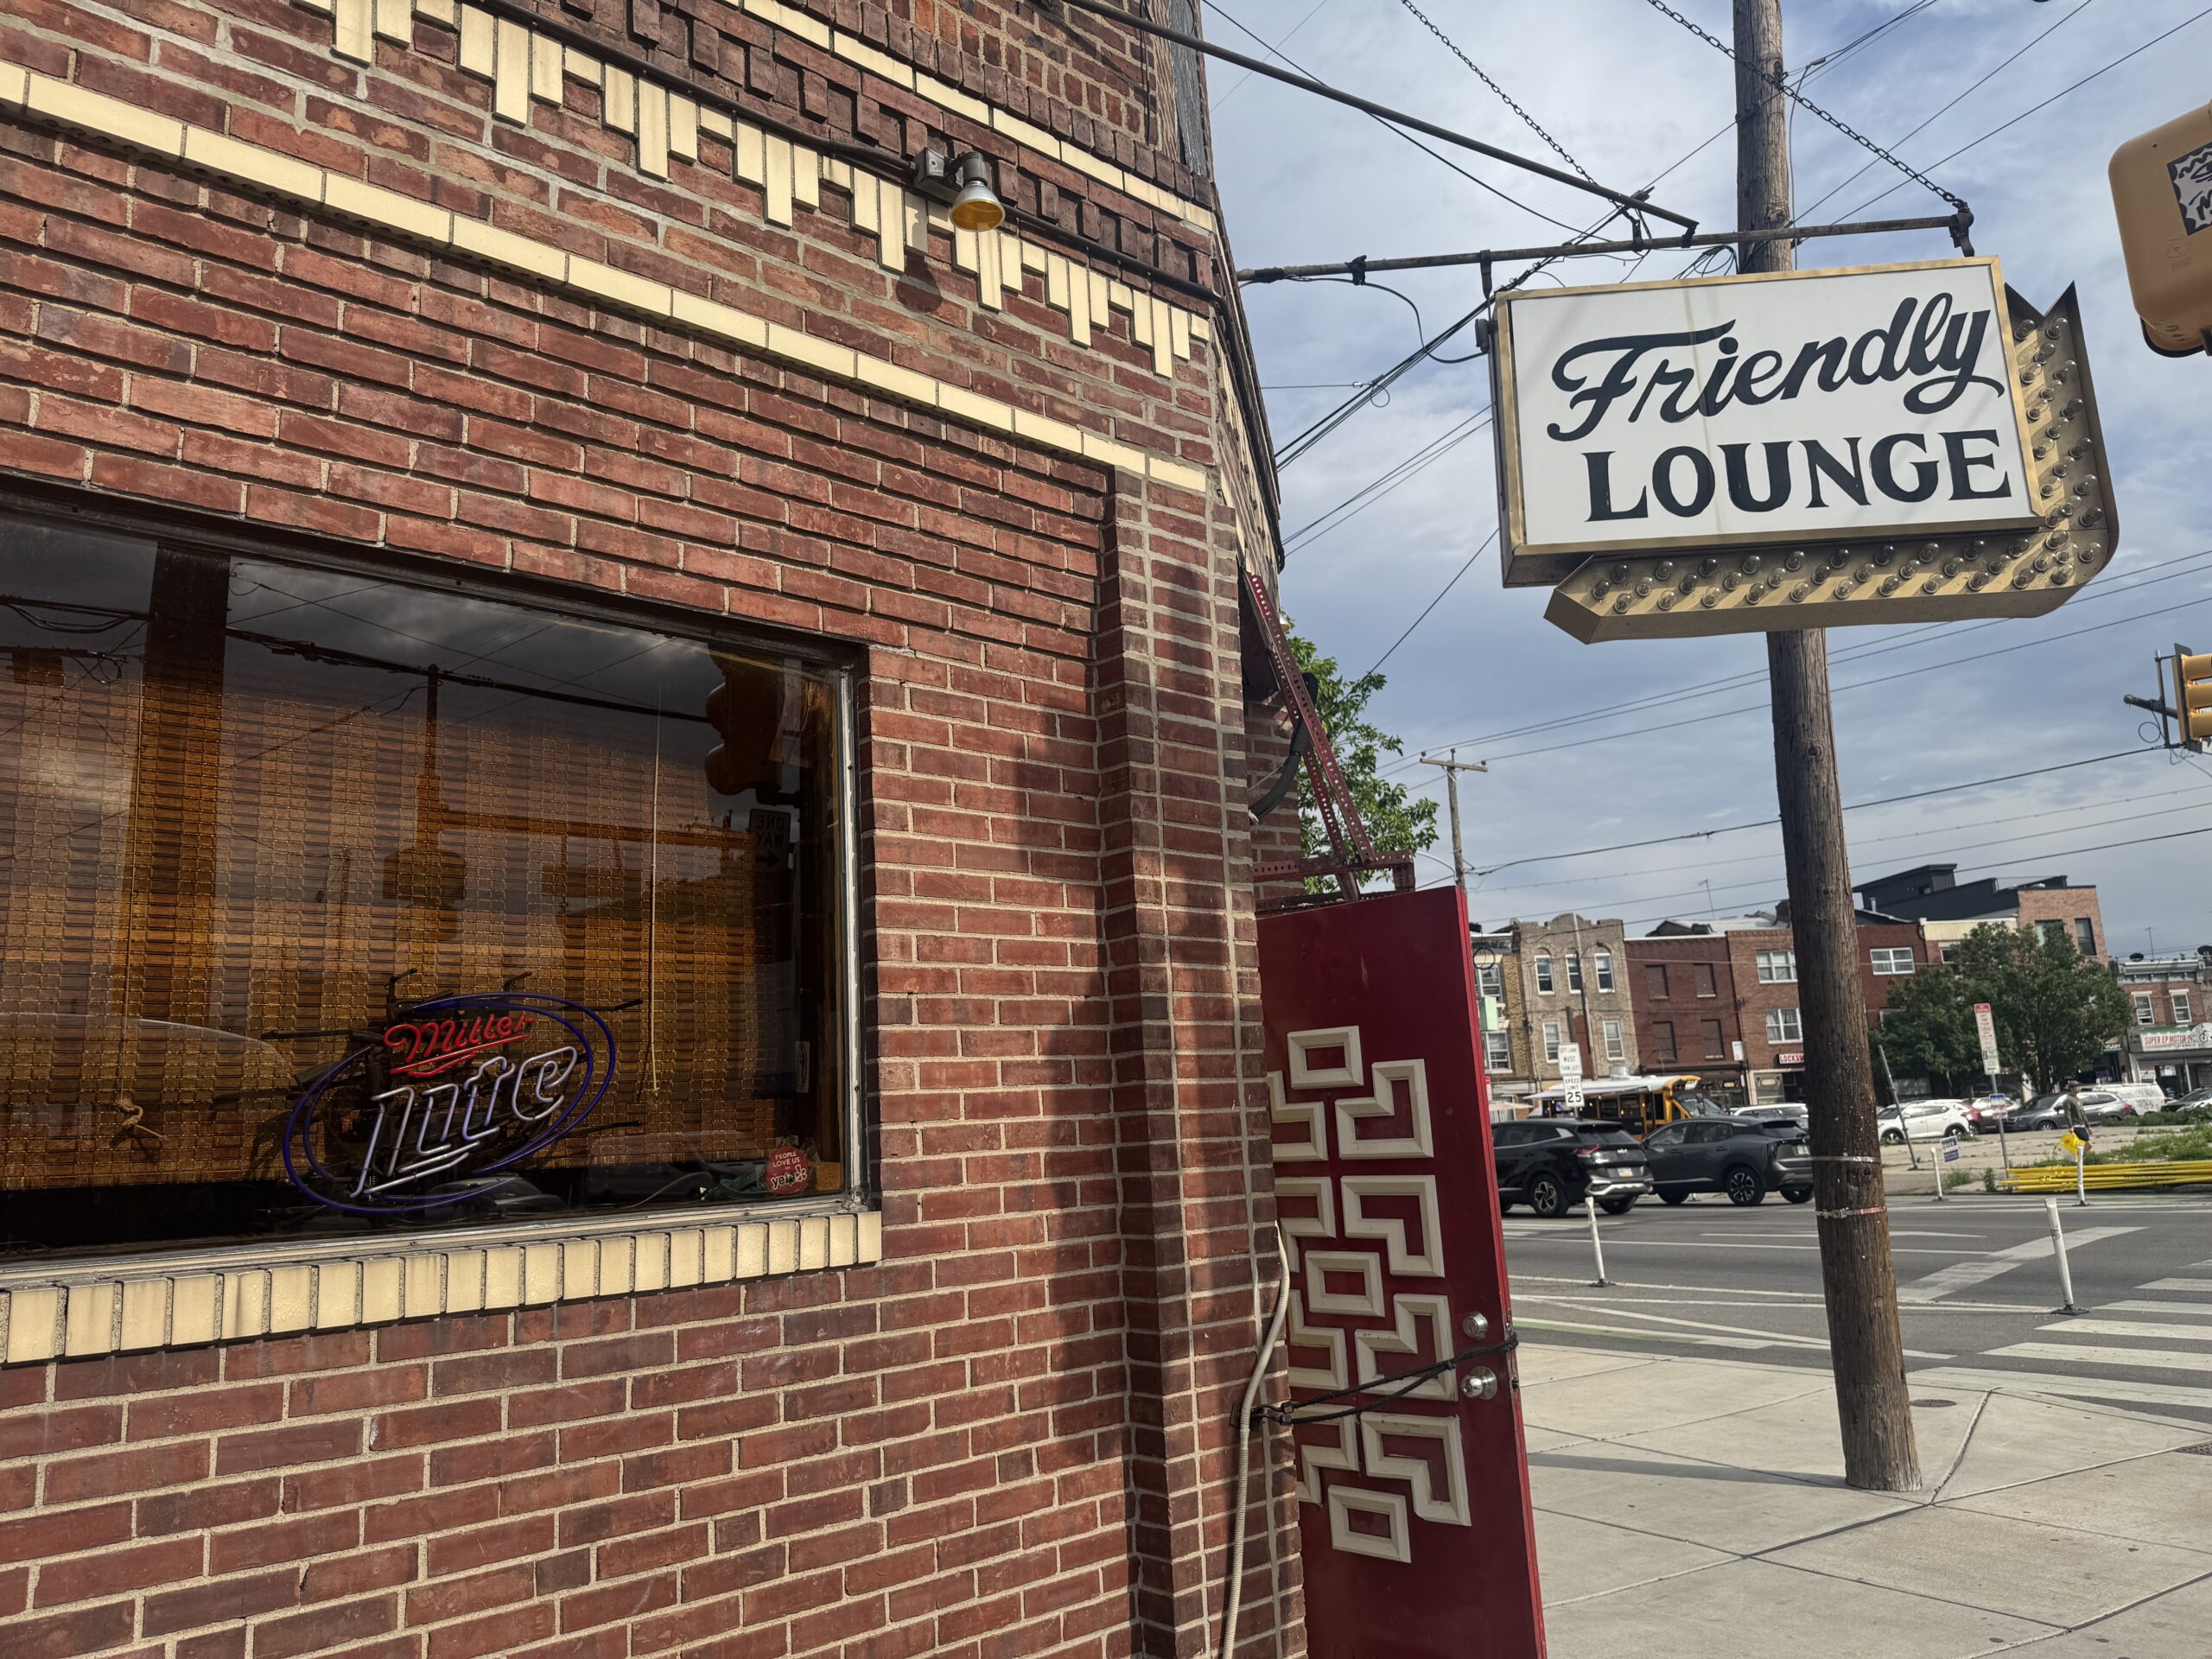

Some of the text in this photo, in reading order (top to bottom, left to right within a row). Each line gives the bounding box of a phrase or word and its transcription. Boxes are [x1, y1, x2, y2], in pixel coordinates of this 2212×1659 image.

[1546, 291, 2005, 442] Friendly
[1584, 429, 2012, 523] LOUNGE
[383, 1013, 537, 1064] Miller
[1567, 1091, 1582, 1103] 25
[349, 1046, 578, 1198] Lite
[772, 1159, 791, 1167] LOVE
[775, 1151, 797, 1160] PEOPLE
[771, 1173, 796, 1190] yelp
